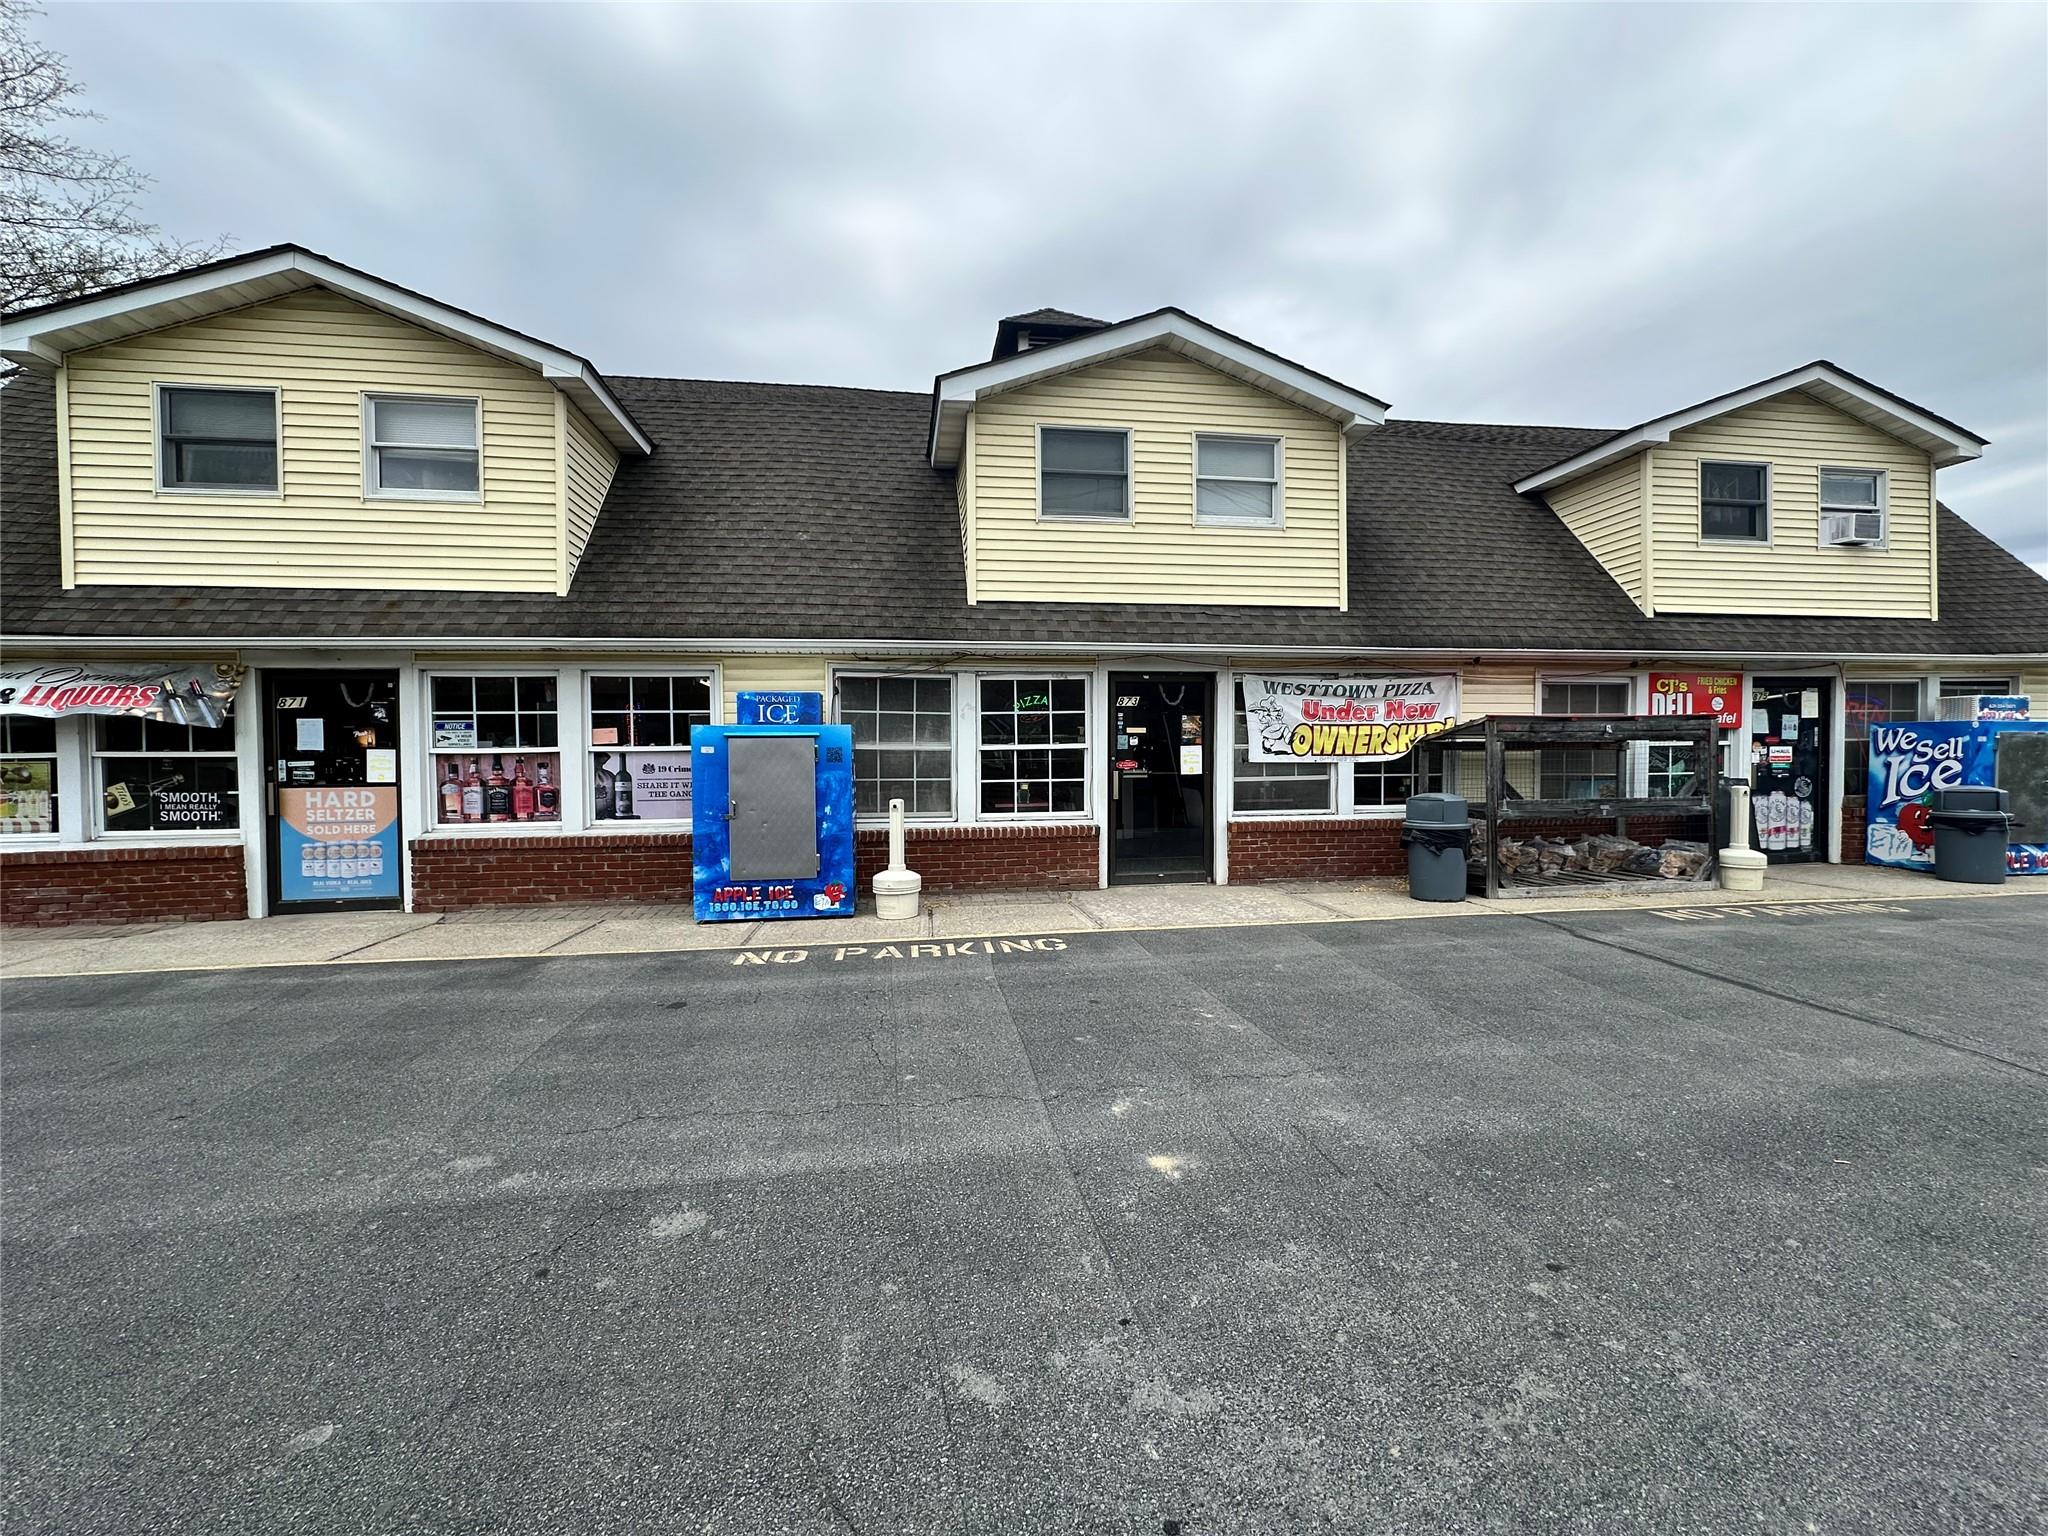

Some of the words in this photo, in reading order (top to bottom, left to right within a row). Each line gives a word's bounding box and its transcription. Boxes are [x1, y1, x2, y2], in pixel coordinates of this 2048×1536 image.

[1263, 680, 1378, 698] WESTTOWN
[1383, 681, 1436, 697] PIZZA
[1657, 679, 1688, 694] CJ's
[19, 684, 162, 712] LIQUORS
[278, 698, 305, 708] 871
[1013, 695, 1048, 712] PIZZA
[1118, 697, 1138, 706] 873
[758, 704, 800, 723] ICE
[1301, 699, 1380, 721] Under
[1384, 699, 1440, 720] New
[1846, 701, 1886, 720] PEN
[1877, 727, 1918, 752] We
[1913, 737, 1964, 762] Sell
[1881, 755, 1963, 806] Ice
[305, 790, 375, 808] HARD
[306, 809, 375, 821] SELTZER
[307, 824, 340, 835] SOLD
[344, 824, 376, 834] HERE
[713, 886, 762, 902] APPLE
[768, 885, 794, 900] ICE
[733, 949, 809, 966] NO
[835, 938, 1069, 961] PARKING
